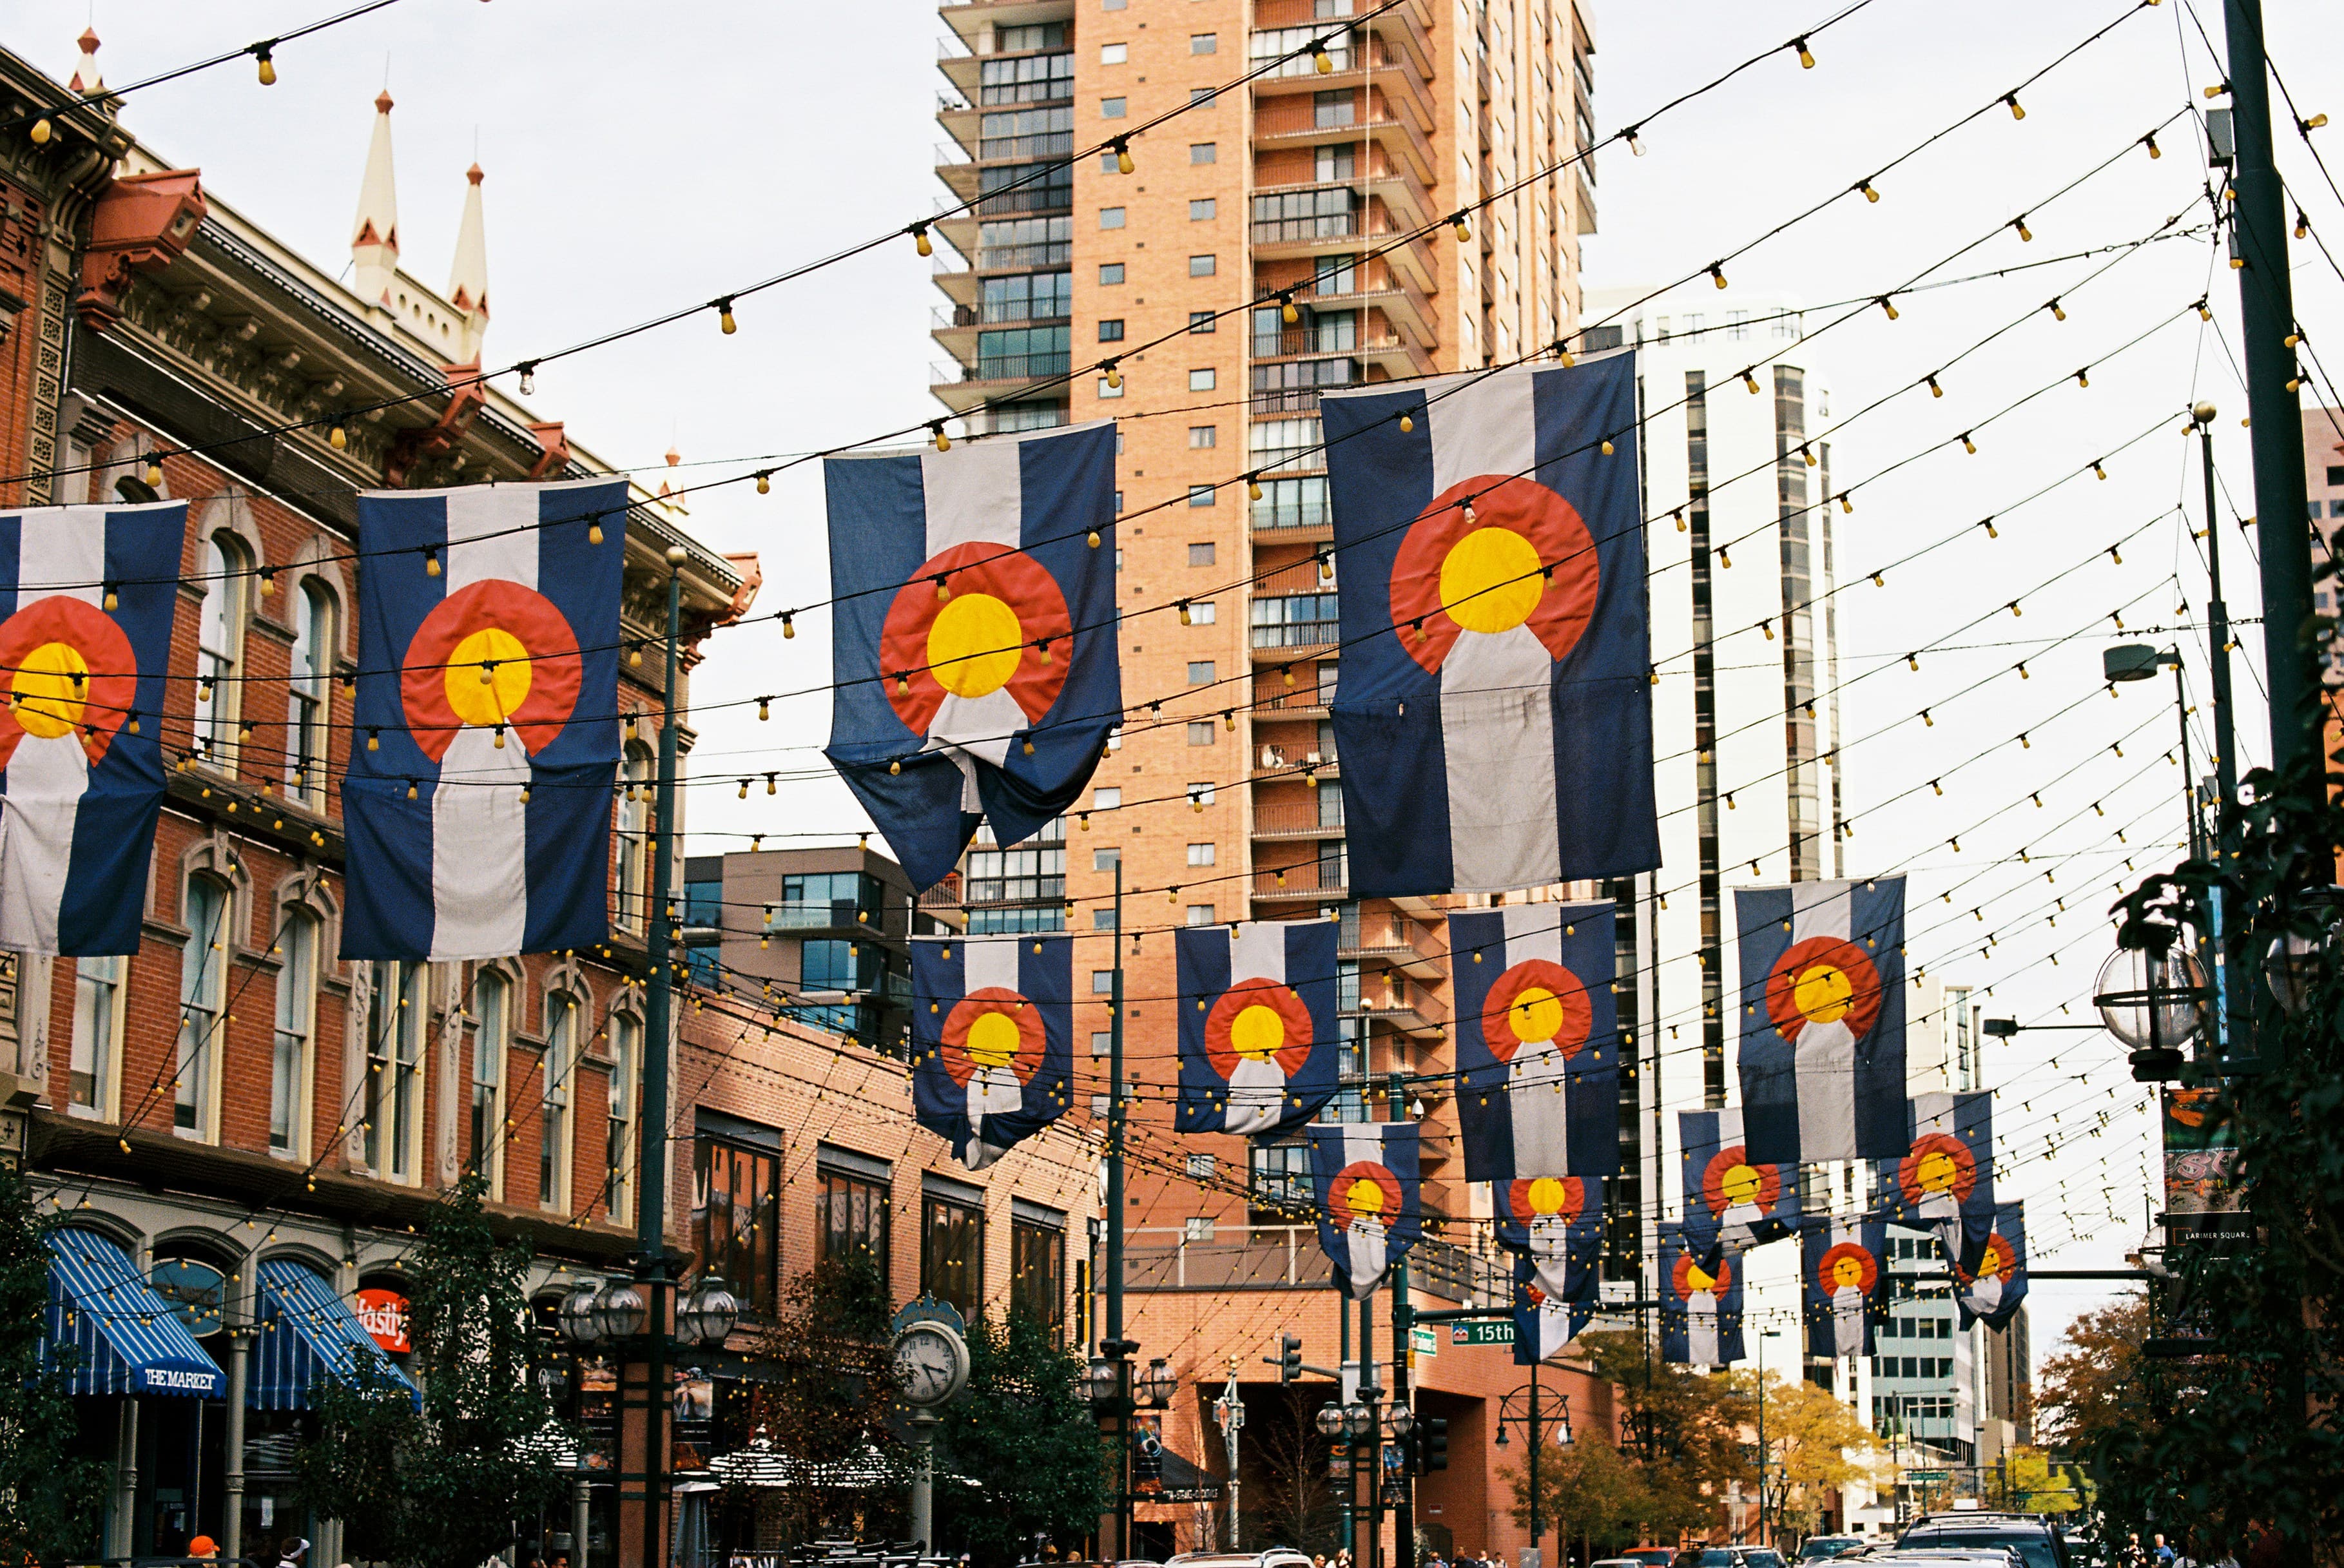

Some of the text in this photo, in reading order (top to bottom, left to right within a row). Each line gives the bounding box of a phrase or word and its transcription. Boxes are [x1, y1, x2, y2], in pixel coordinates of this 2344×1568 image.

[2185, 1232, 2217, 1240] LARIMER
[1477, 1324, 1515, 1341] 15th
[920, 1335, 929, 1346] 12
[145, 1368, 216, 1390] THE MARKET
